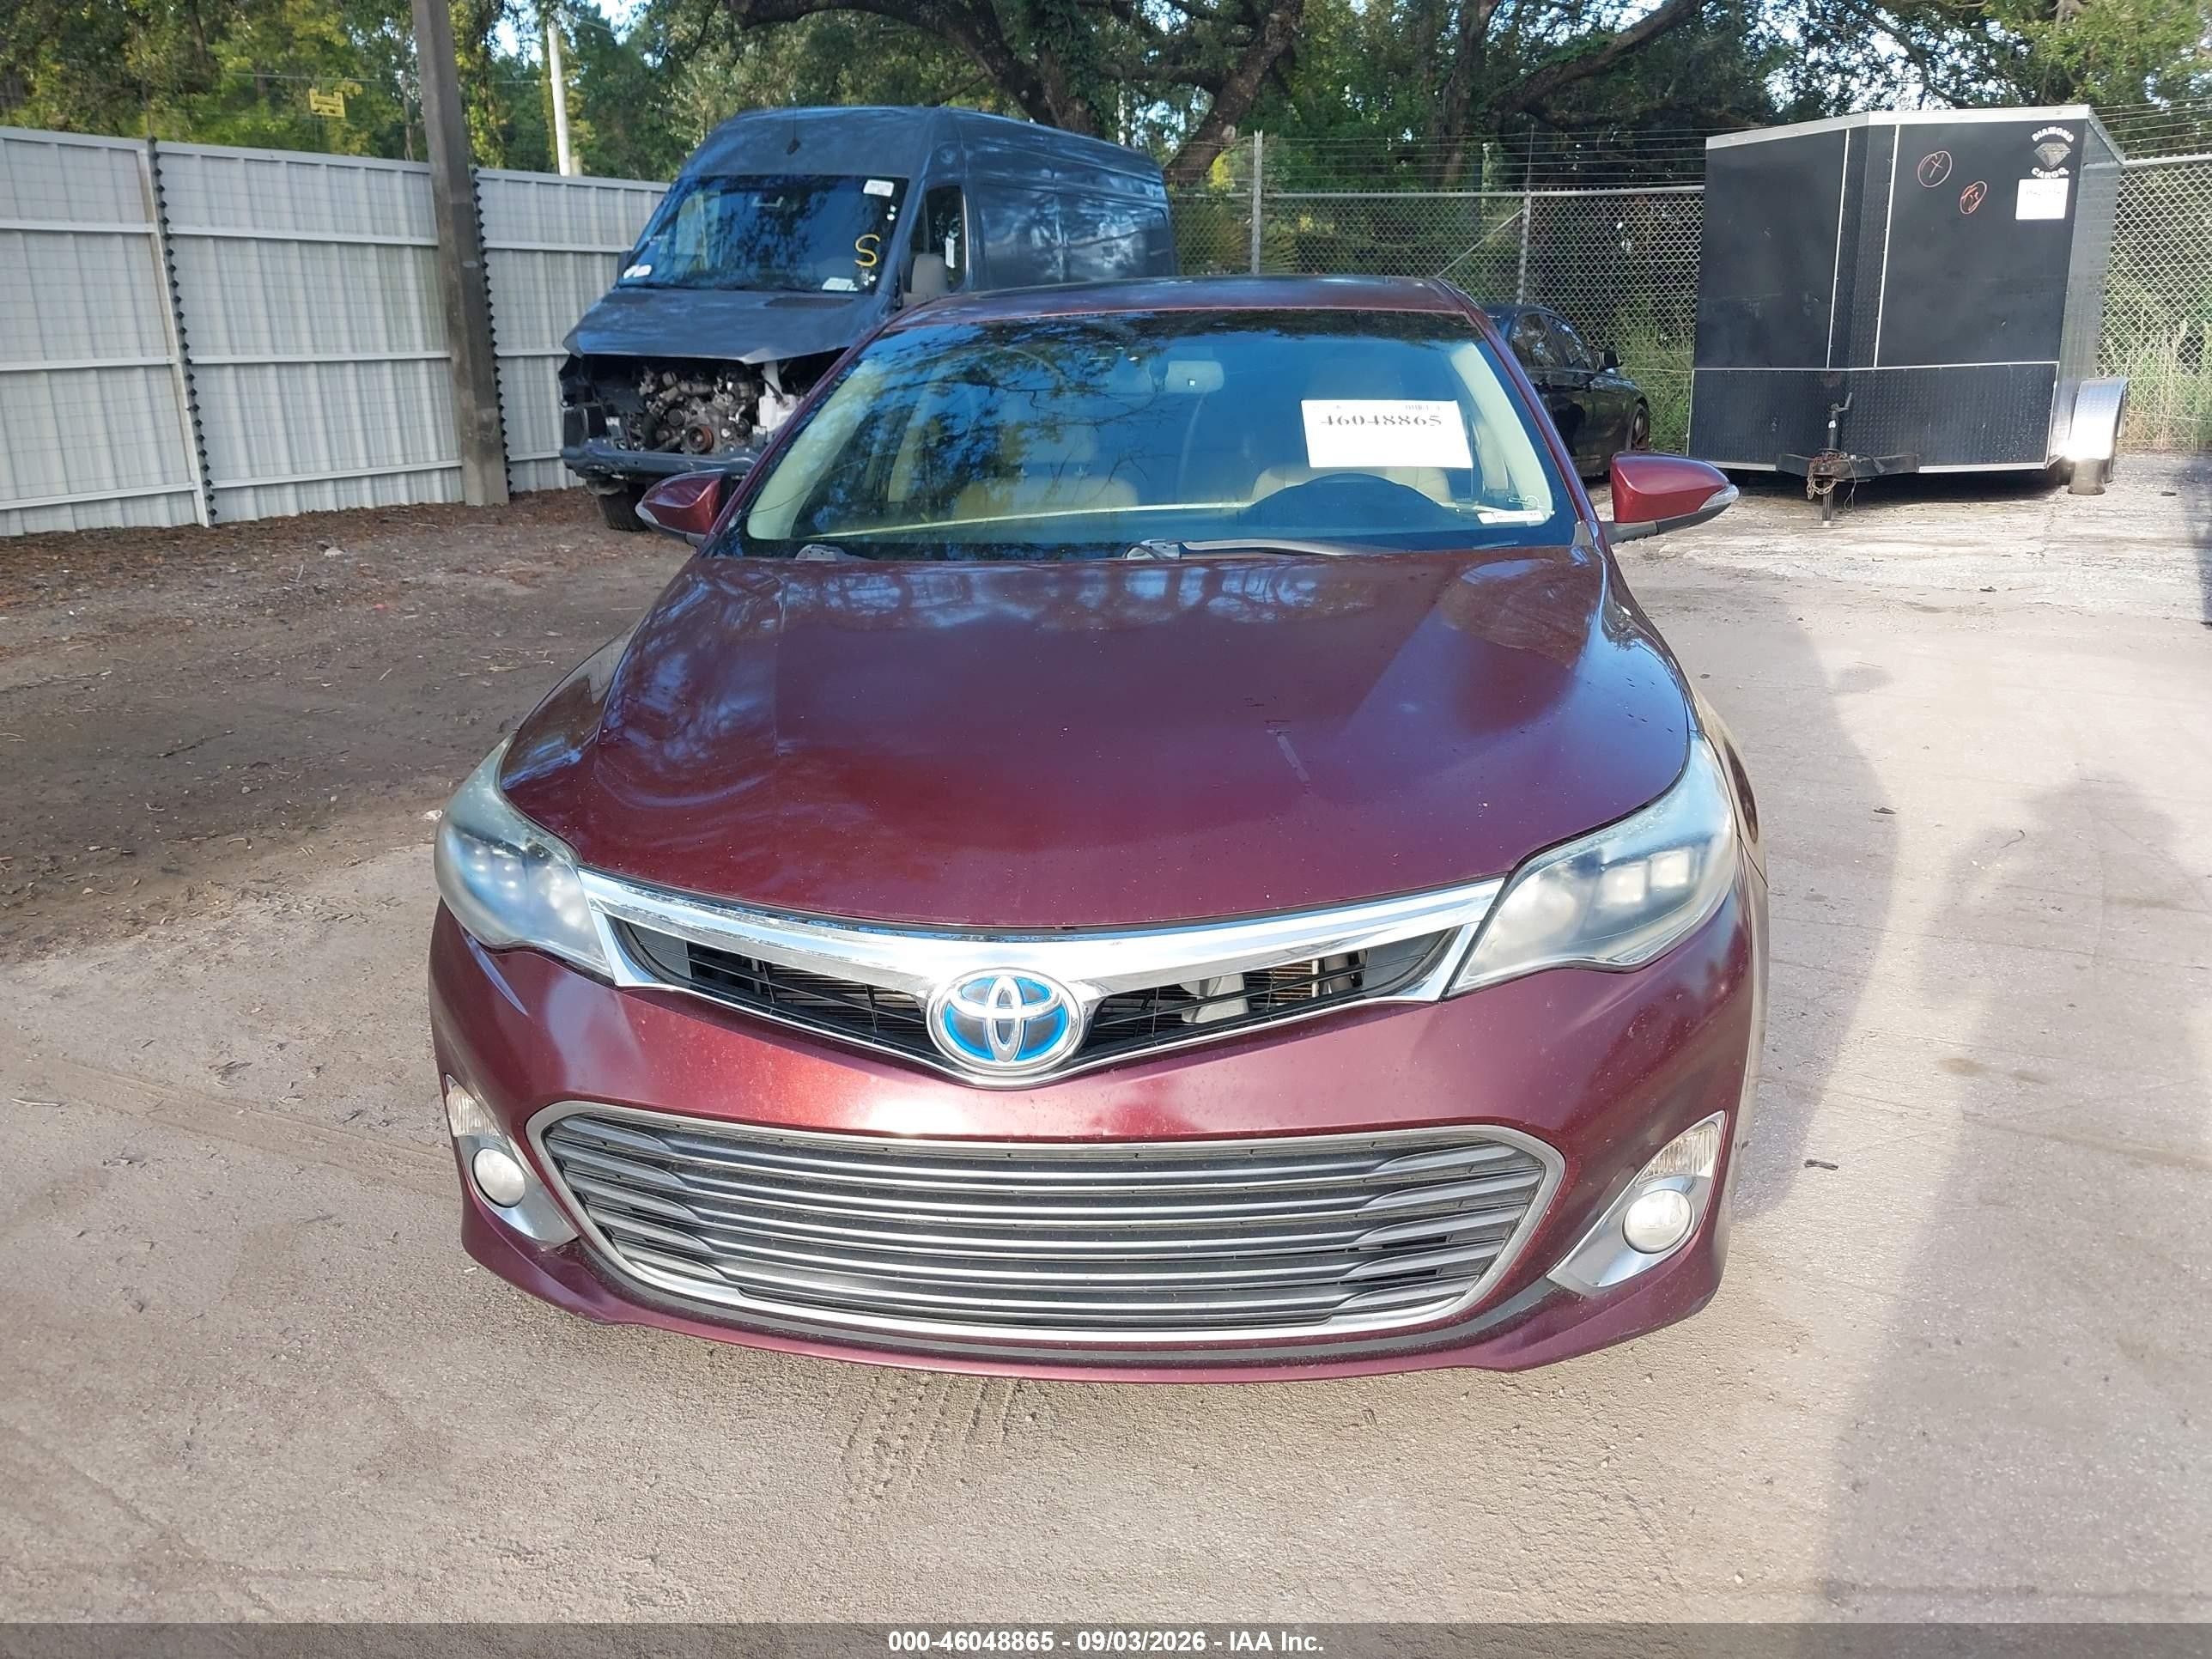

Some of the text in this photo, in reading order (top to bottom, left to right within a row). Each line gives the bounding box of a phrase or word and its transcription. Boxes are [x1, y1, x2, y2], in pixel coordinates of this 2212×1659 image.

[2031, 125, 2075, 143] DIAMOND
[854, 234, 880, 267] S
[1321, 415, 1442, 427] 46048865
